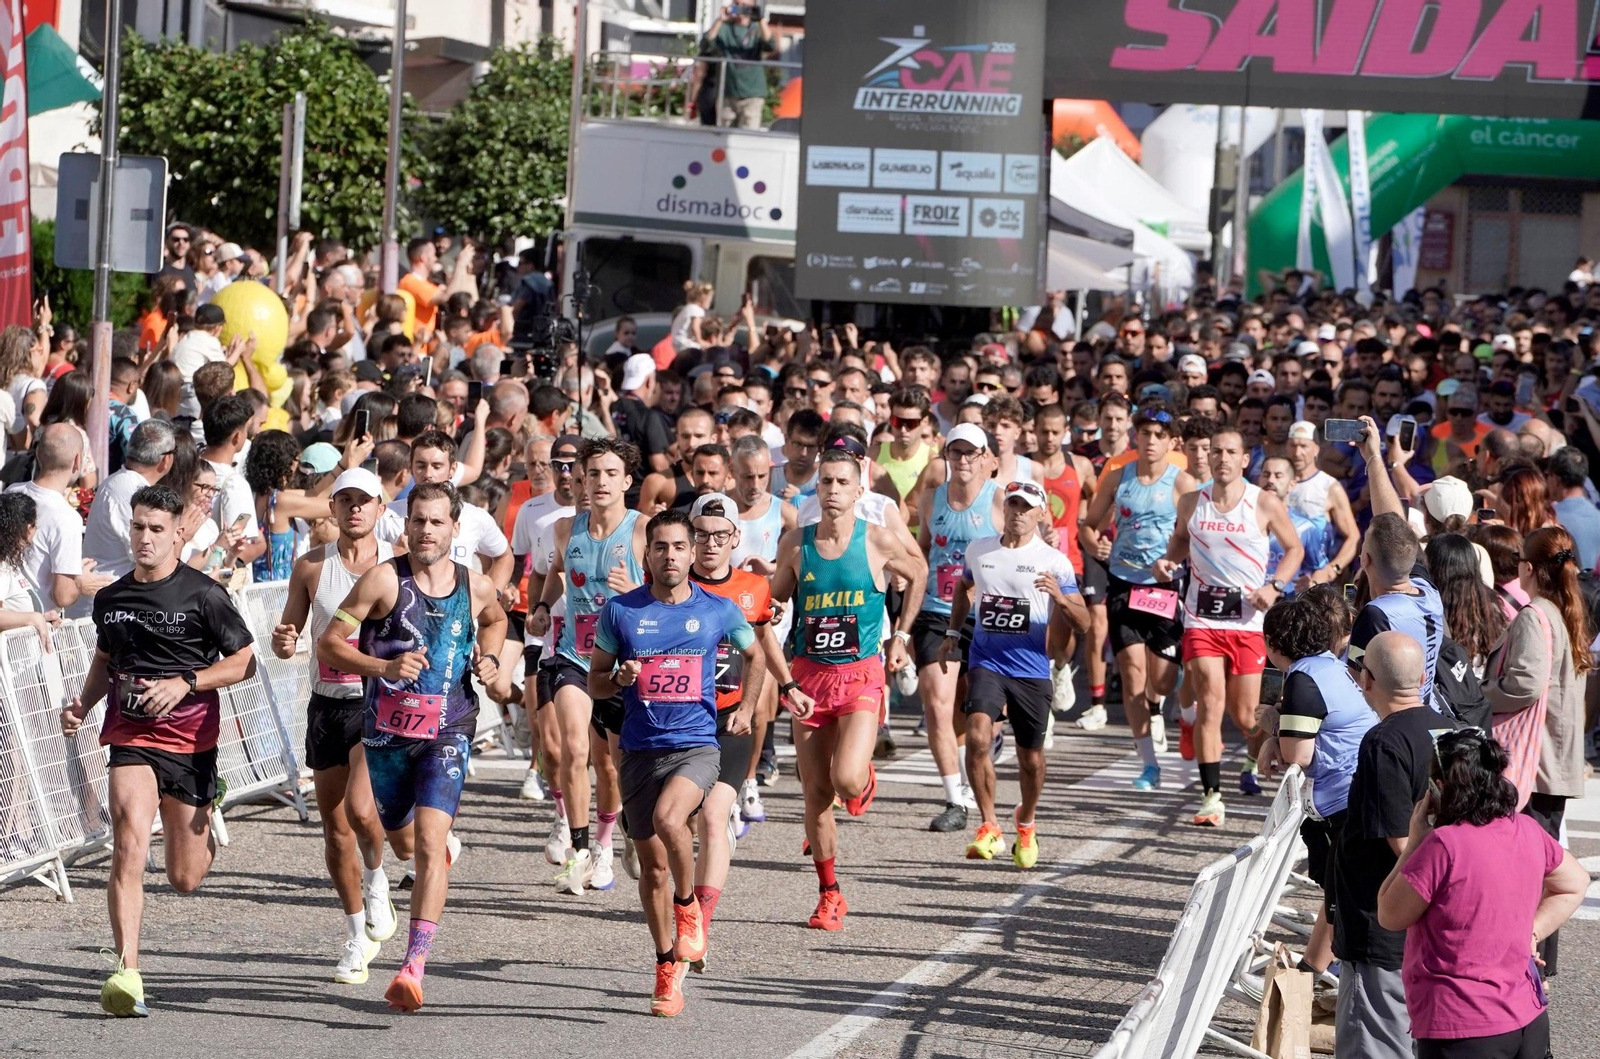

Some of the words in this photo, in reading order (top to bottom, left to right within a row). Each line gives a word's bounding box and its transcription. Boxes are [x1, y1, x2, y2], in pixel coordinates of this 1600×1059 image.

[1110, 0, 1579, 83] SAIDA
[900, 50, 1016, 94] CAE
[862, 90, 1018, 113] INTERRUNNING
[1470, 125, 1492, 144] el
[656, 194, 764, 220] dismaboc
[913, 205, 960, 220] FROIZ
[1199, 521, 1245, 533] TREGA
[804, 590, 864, 611] BIKILA
[1137, 597, 1168, 612] 689
[1211, 600, 1224, 613] 3
[104, 611, 136, 624] CUPA
[136, 611, 187, 625] GROUP
[981, 610, 1025, 628] 268
[144, 624, 164, 633] Since
[166, 625, 186, 634] 1892
[814, 631, 846, 648] 98
[667, 647, 708, 657] vilagarcía
[648, 675, 690, 693] 528
[389, 710, 426, 731] 617
[414, 930, 432, 940] ONE
